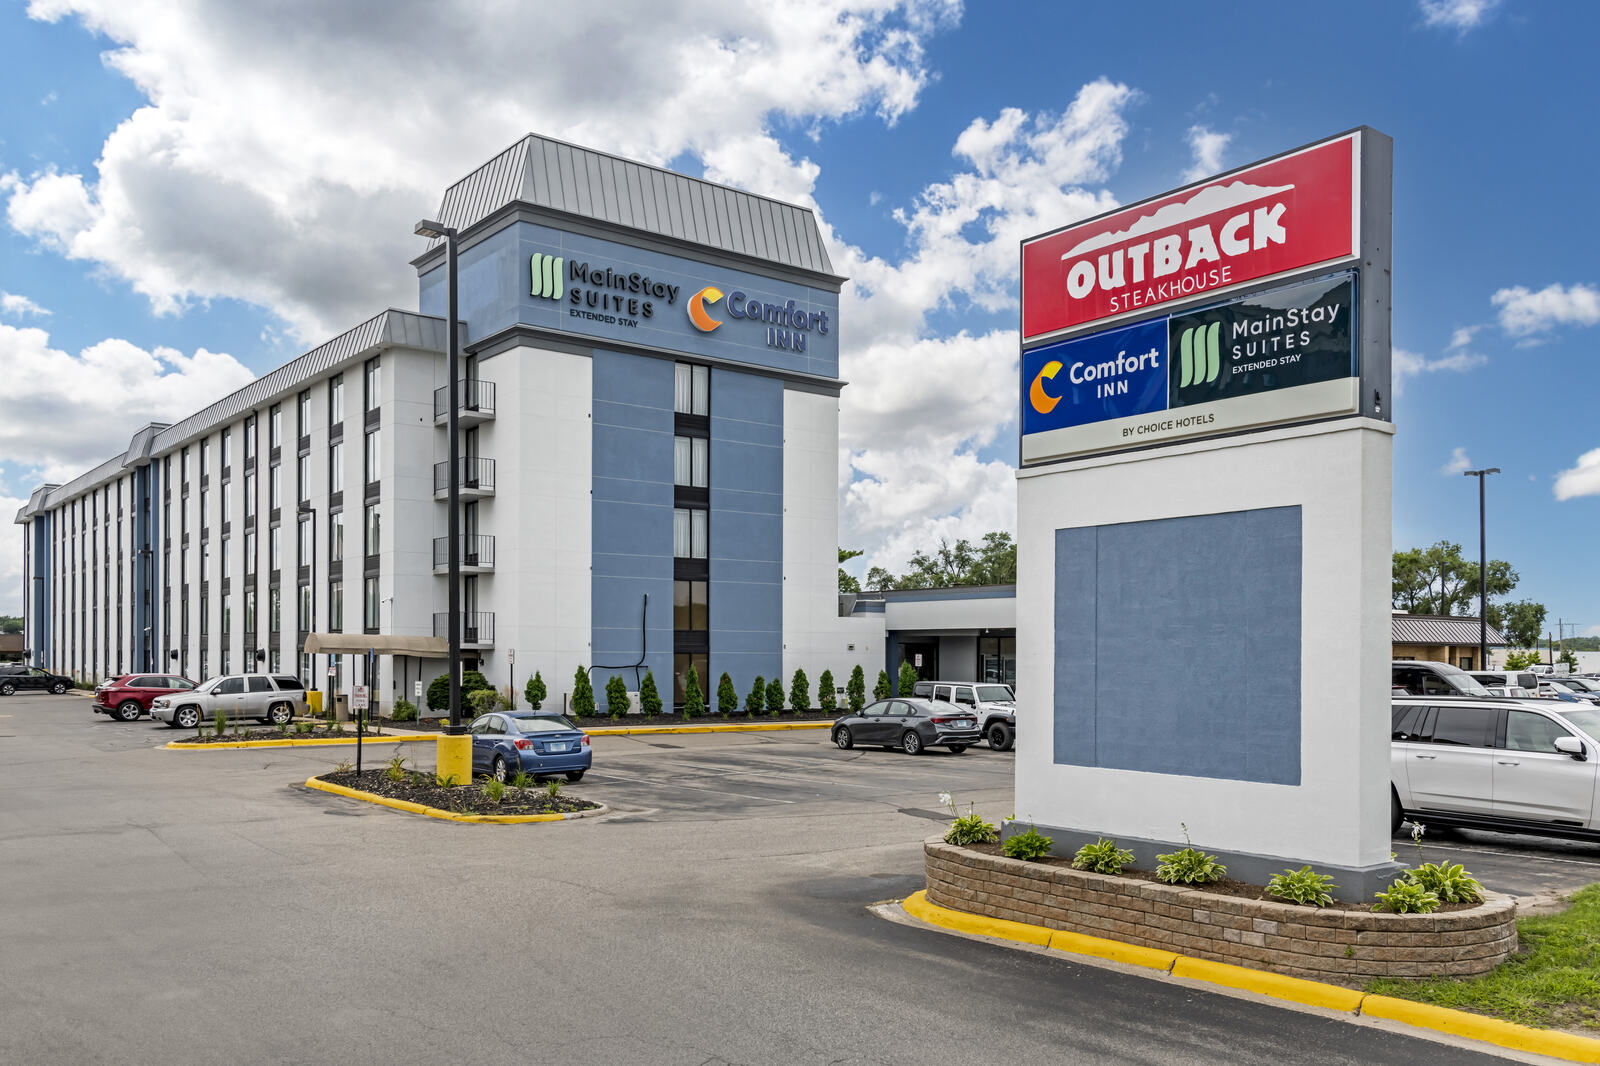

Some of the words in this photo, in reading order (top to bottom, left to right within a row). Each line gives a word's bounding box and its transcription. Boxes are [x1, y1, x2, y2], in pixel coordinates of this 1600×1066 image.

[1066, 202, 1287, 299] OUTBACK
[569, 259, 680, 301] MainStay
[1110, 265, 1232, 312] STEAKHOUSE
[569, 286, 654, 318] SUITES
[726, 290, 829, 334] Comfort
[569, 308, 616, 325] EXTENDED
[618, 317, 639, 329] STAY
[1232, 303, 1340, 339] MainStay
[766, 327, 806, 352] INN
[1232, 330, 1311, 360] SUITES
[1069, 347, 1159, 384] Comfort
[1232, 358, 1278, 374] EXTENDED
[1279, 353, 1302, 366] STAY
[1097, 380, 1128, 399] INN
[1122, 426, 1135, 437] BY
[1137, 420, 1173, 435] CHOICE
[1175, 413, 1215, 430] HOTELS
